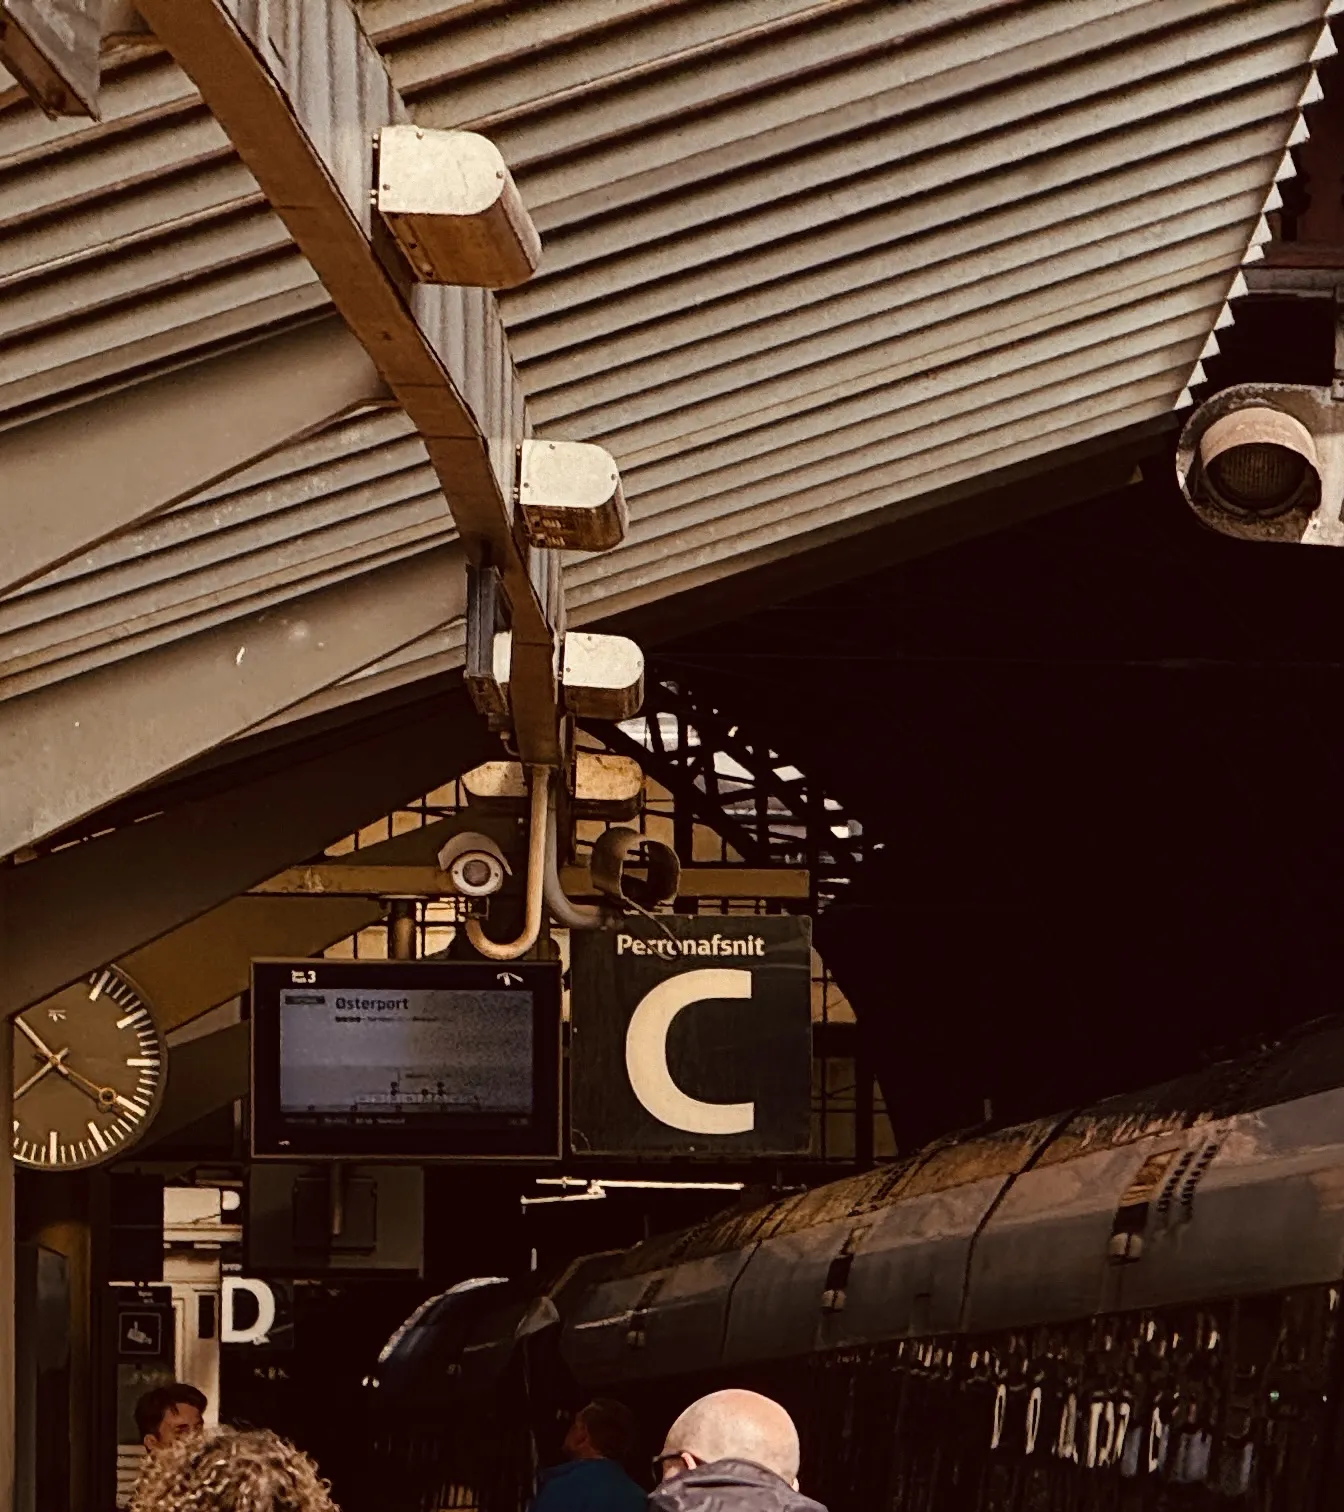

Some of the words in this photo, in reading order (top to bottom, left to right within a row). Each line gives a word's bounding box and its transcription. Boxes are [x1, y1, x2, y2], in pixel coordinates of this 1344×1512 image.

[616, 933, 766, 957] Perronafsnit
[307, 970, 317, 984] 3
[334, 996, 410, 1012] Østerport
[625, 968, 755, 1135] C
[221, 1275, 276, 1344] D
